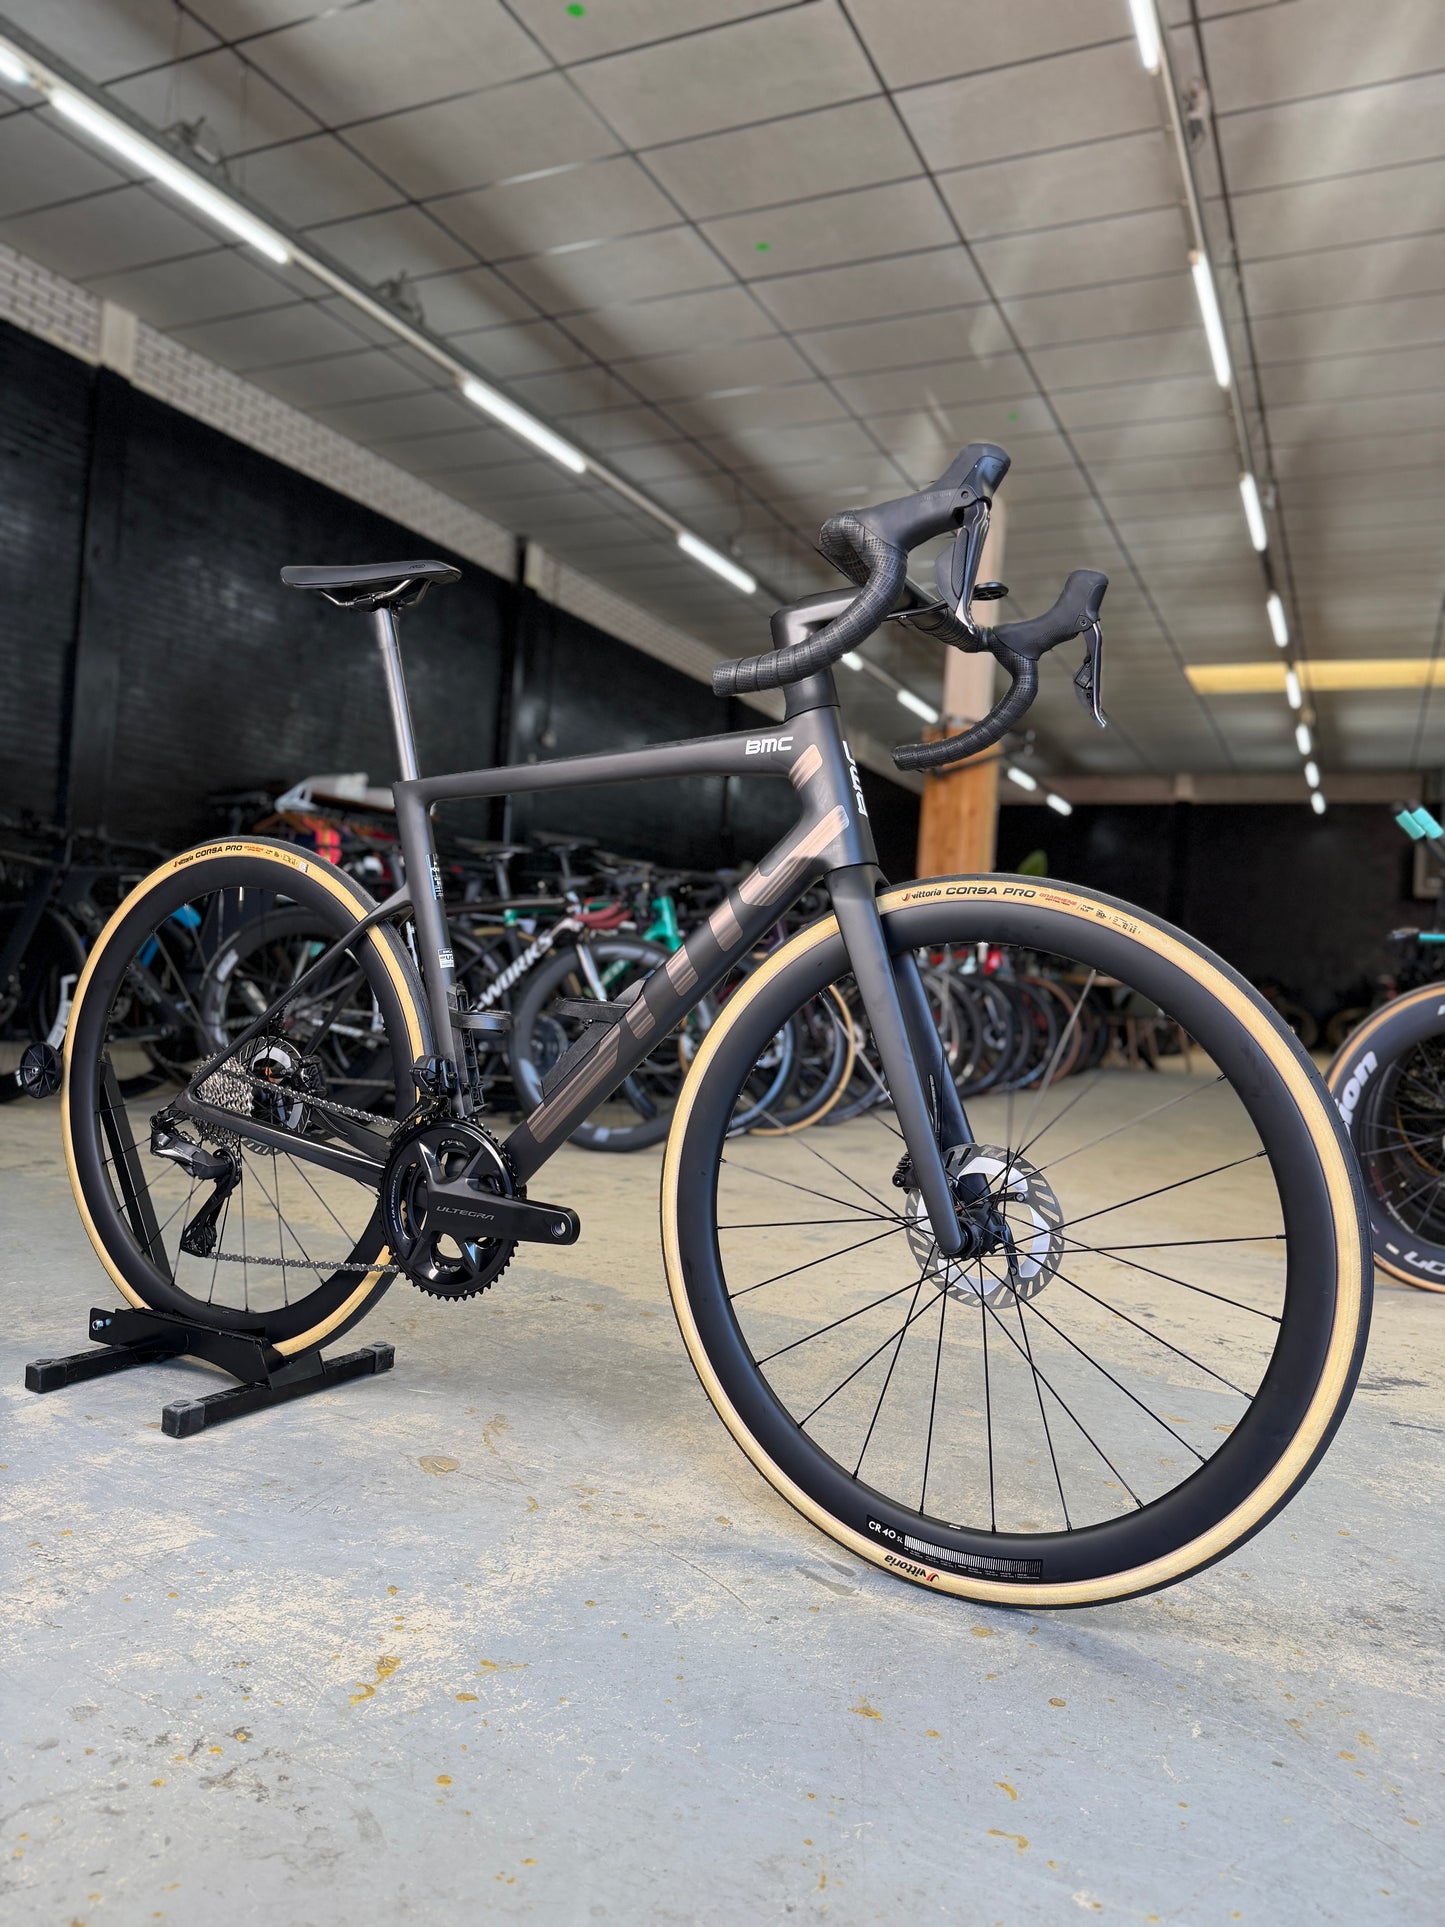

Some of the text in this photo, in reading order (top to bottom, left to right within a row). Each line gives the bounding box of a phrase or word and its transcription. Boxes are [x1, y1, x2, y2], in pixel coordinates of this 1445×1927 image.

[745, 736, 794, 755] BMC
[195, 847, 223, 859] CORSA
[911, 886, 1037, 900] vittoria CORSA PRO
[474, 933, 553, 1011] -WORKS
[1334, 1050, 1378, 1137] ion
[436, 1205, 495, 1221] ULTEGRA
[868, 1520, 882, 1534] CR
[882, 1528, 897, 1539] 40
[884, 1554, 927, 1578] vittoria
